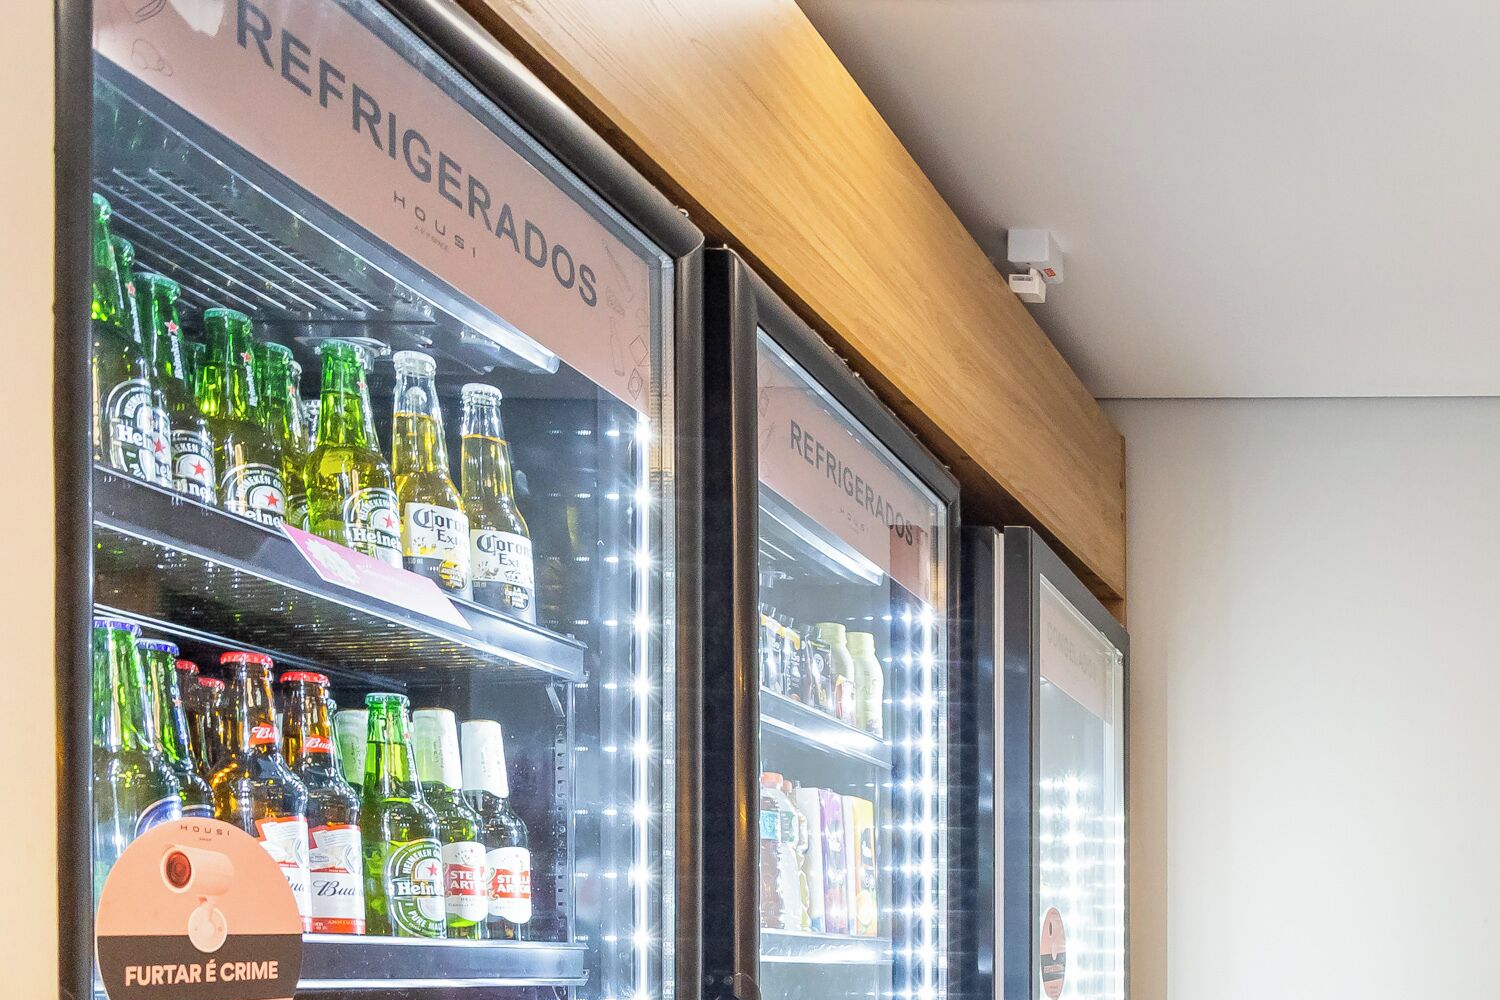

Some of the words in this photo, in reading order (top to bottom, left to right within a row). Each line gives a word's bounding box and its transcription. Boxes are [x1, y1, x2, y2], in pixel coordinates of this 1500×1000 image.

[235, 0, 600, 308] REFRIGERADOS
[393, 190, 476, 259] HOUSI
[789, 418, 914, 546] REFRIGERADOS
[180, 824, 231, 837] HOUSI
[125, 964, 202, 987] FURTAR
[206, 959, 217, 983] É
[220, 960, 279, 981] CRIME
